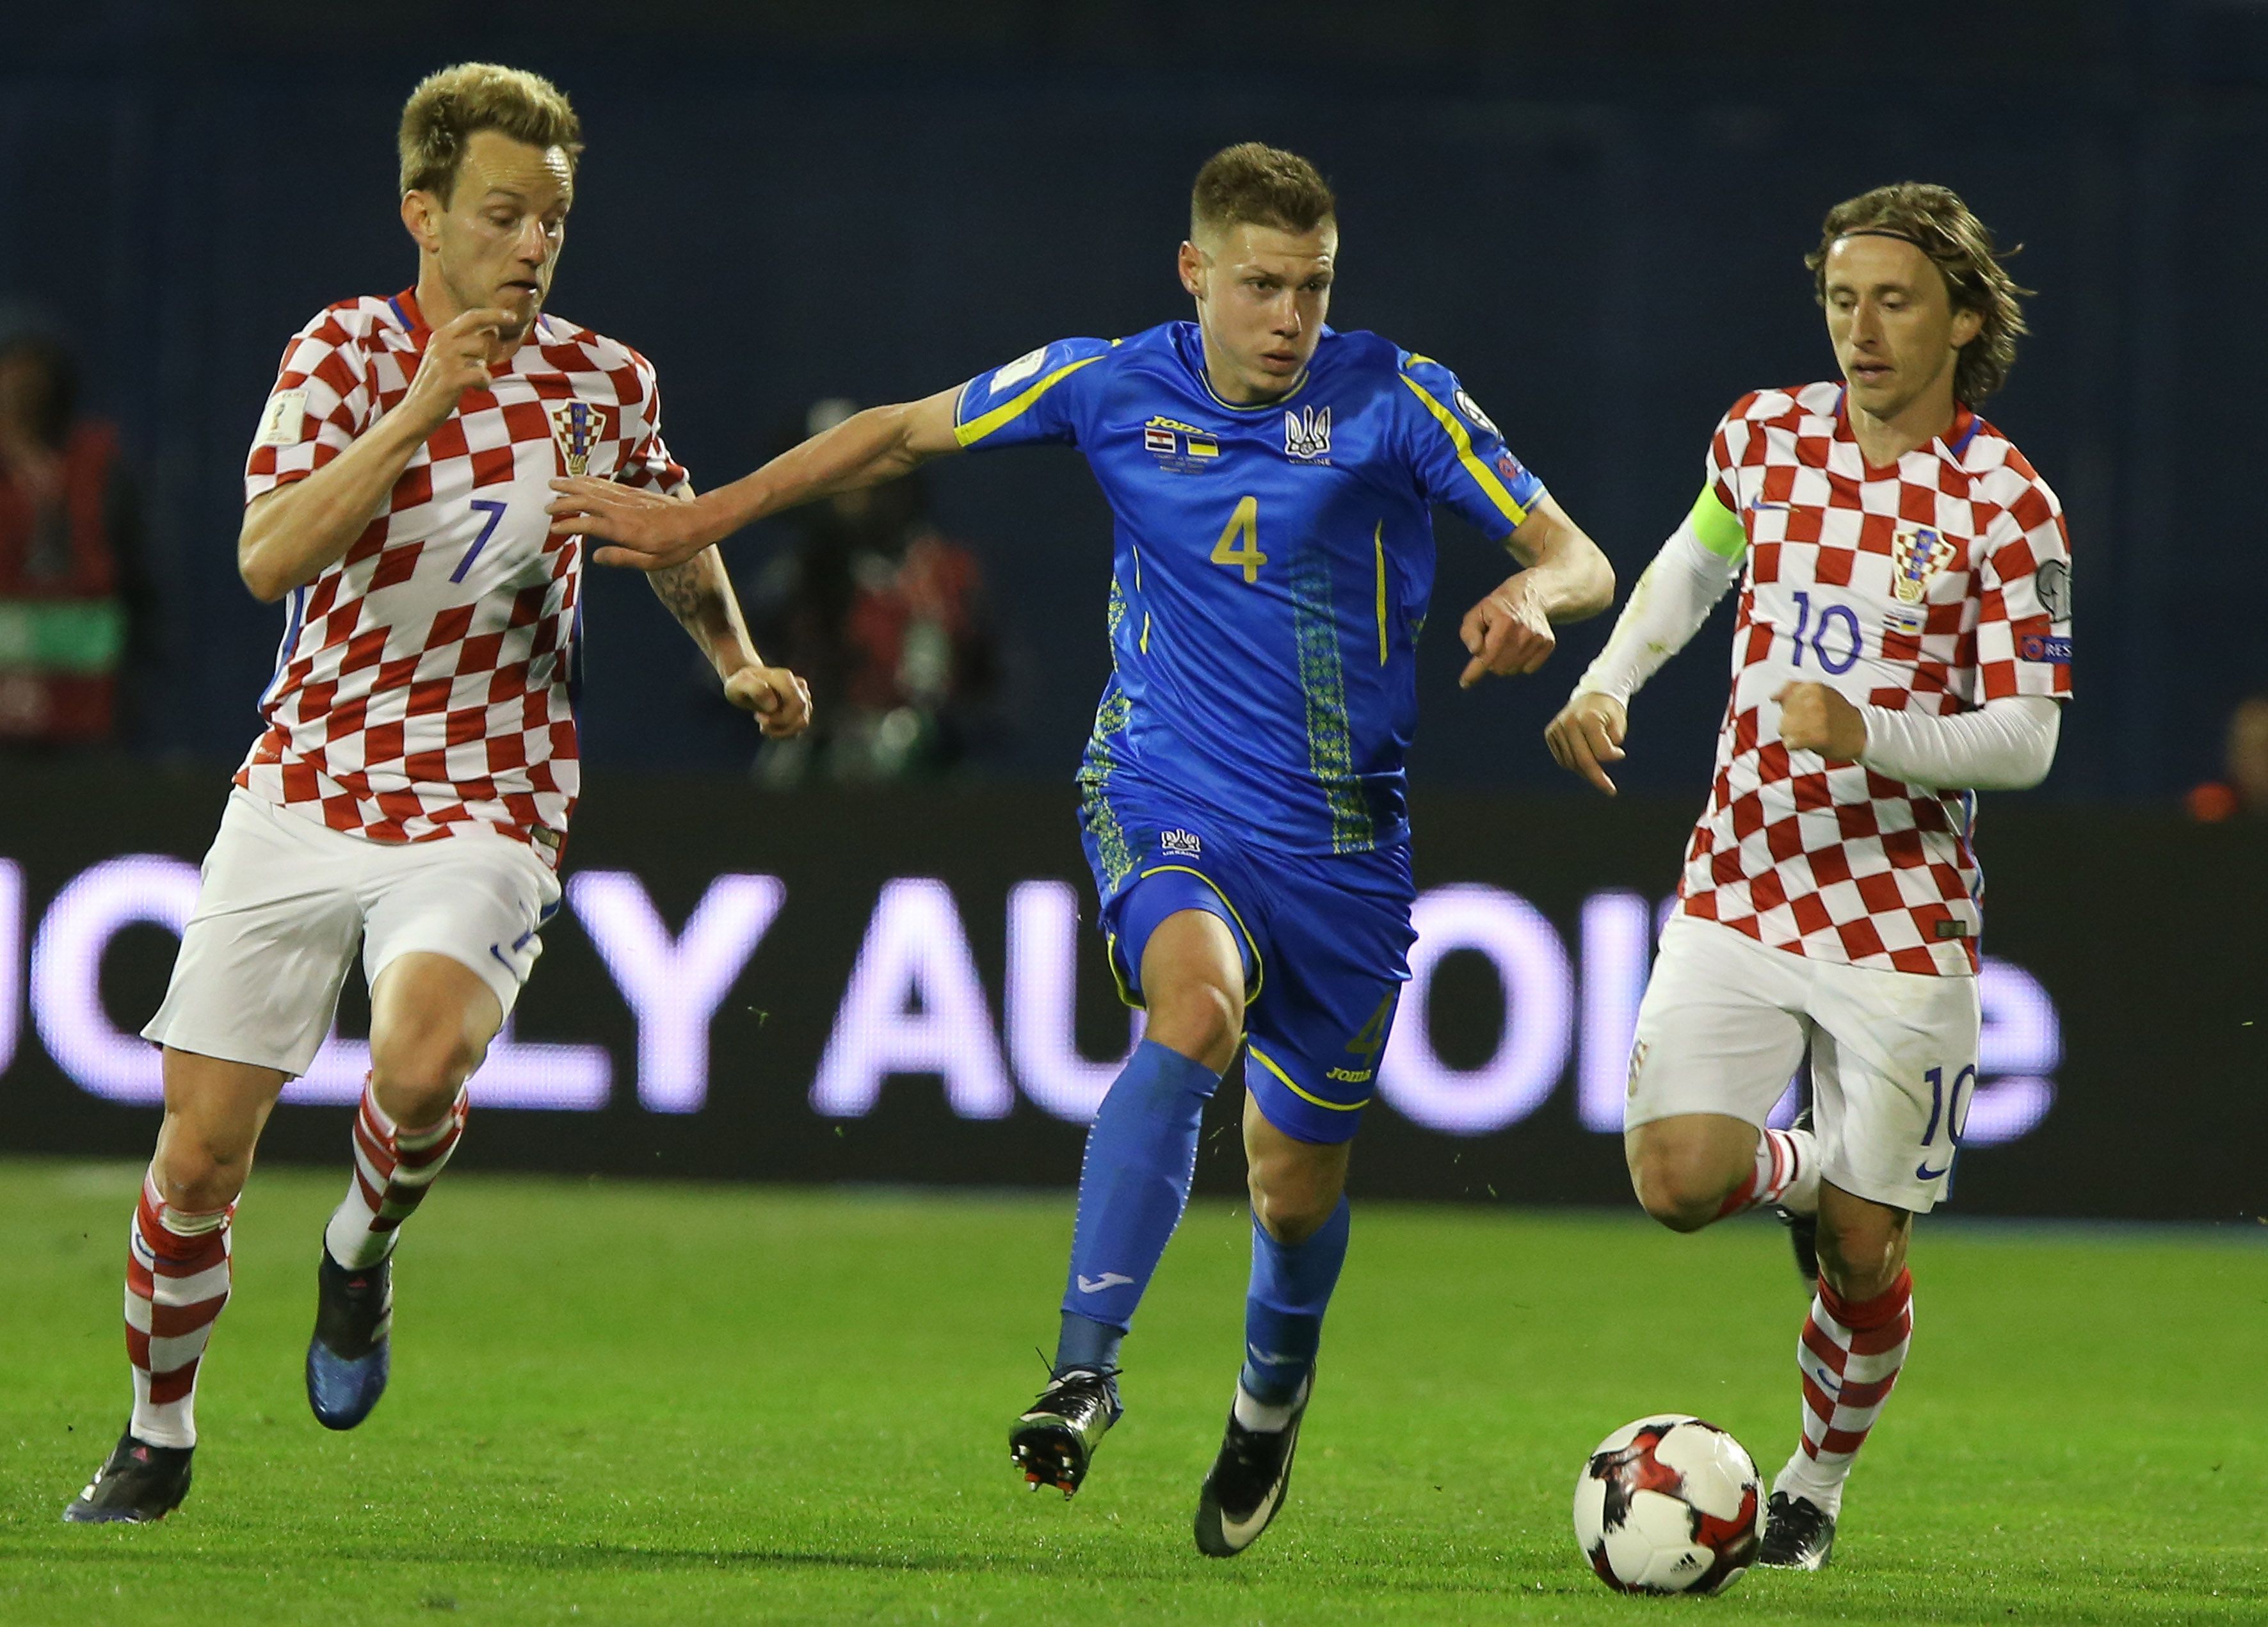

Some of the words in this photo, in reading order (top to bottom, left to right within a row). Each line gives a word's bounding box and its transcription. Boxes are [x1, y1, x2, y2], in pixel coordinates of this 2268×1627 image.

[449, 500, 508, 583] 7
[1209, 496, 1267, 583] 4
[1792, 592, 1862, 674] 10
[1346, 990, 1394, 1068] 4
[1921, 1064, 1977, 1147] 10
